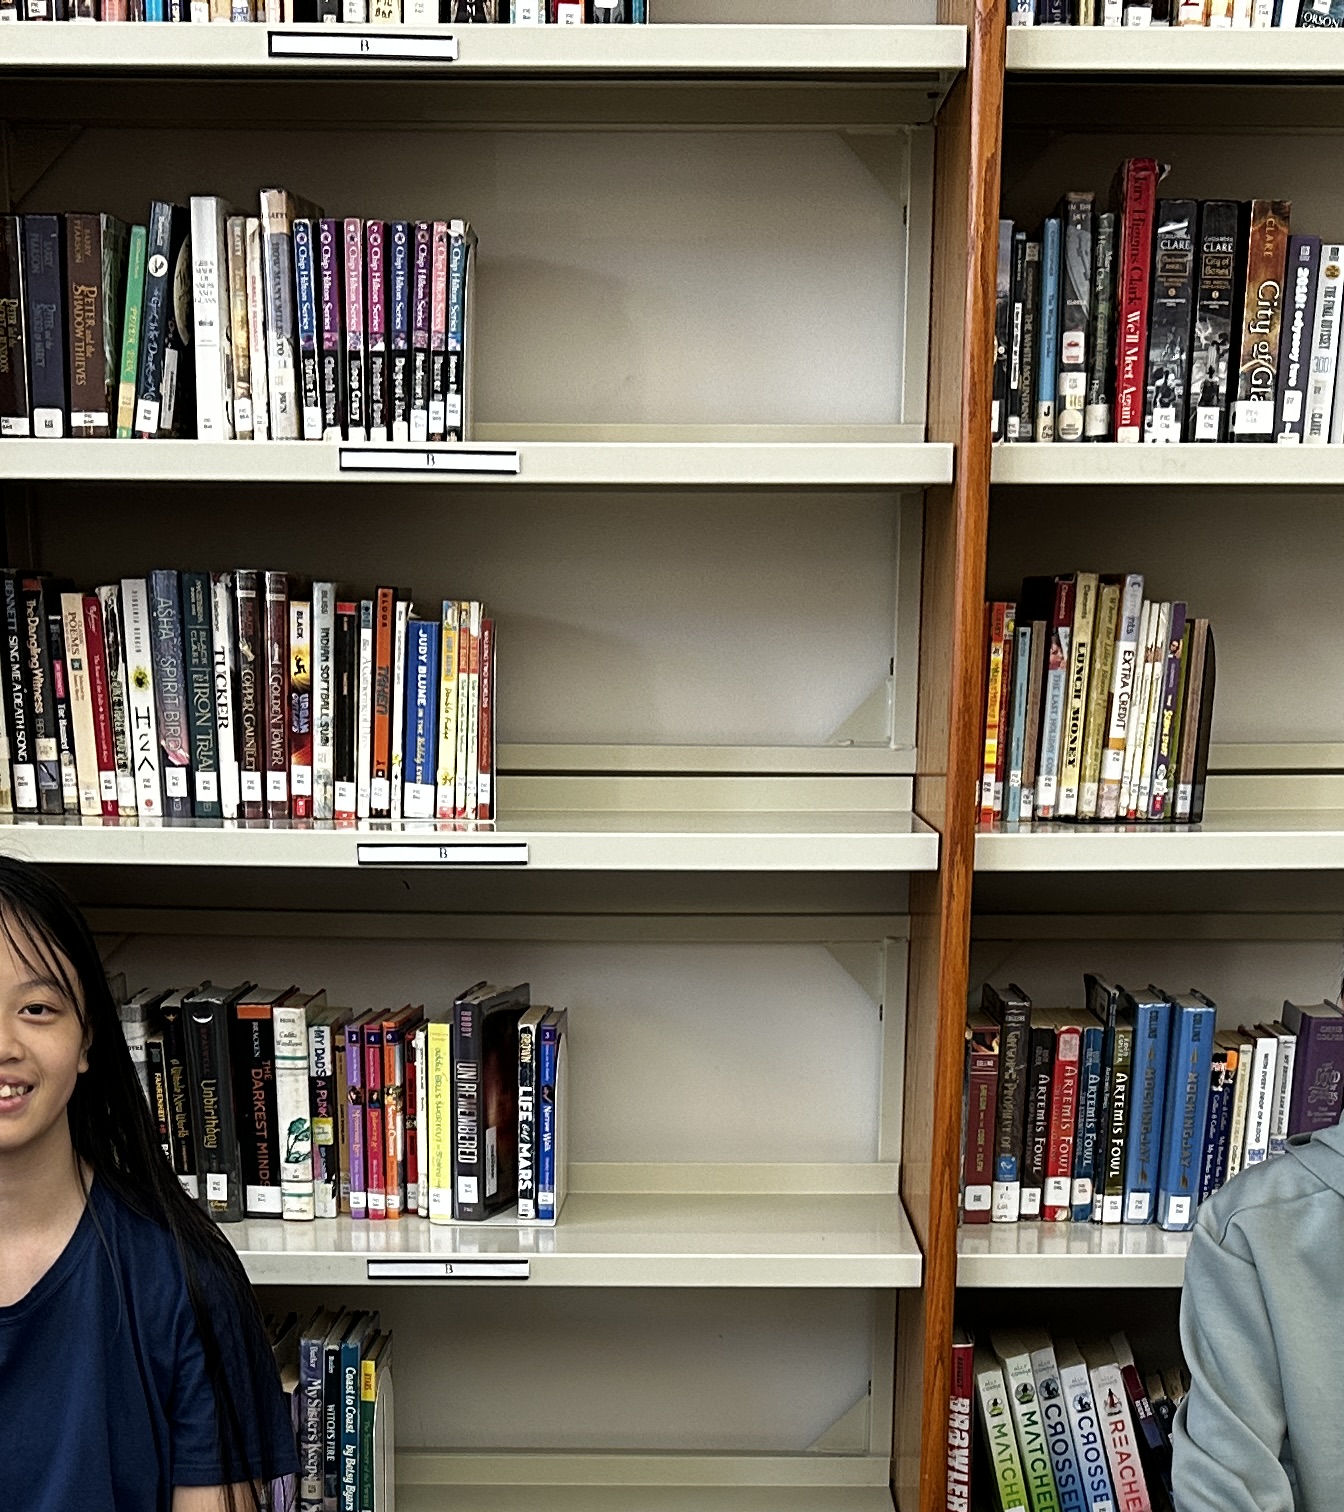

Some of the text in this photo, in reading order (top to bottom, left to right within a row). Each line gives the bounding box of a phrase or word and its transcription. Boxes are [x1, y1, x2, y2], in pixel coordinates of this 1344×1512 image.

[360, 39, 370, 52] B
[1160, 240, 1190, 250] CLARE
[1204, 243, 1233, 252] CLARE
[1265, 218, 1275, 257] CLARE
[82, 285, 97, 328] PETER
[394, 246, 404, 329] Chip Hilton Series
[1250, 281, 1280, 361] City of
[73, 283, 86, 385] SHADOW THIEVES
[1119, 310, 1141, 425] We'll Meet Again
[426, 453, 436, 466] B
[26, 617, 41, 668] Dangling
[296, 611, 304, 639] BLACK
[8, 635, 27, 762] SING ME A DEATH SONG
[31, 669, 44, 714] Witness
[157, 598, 182, 751] ASHA SPIRIT BIRD
[193, 682, 212, 726] IRON
[214, 646, 229, 729] TUCKER
[417, 629, 427, 707] JUDY BLUME
[1066, 642, 1087, 769] LUNCH MONEY
[1115, 650, 1135, 731] EXTRA CREDIT
[270, 673, 284, 766] GOLDEN TOWER
[439, 847, 448, 859] B
[261, 1060, 272, 1080] THE
[519, 1086, 533, 1122] LIFE
[200, 1079, 220, 1149] Unbirthday
[251, 1068, 271, 1187] DARKEST MINDS
[457, 1062, 478, 1164] UNREMEMBERED
[1057, 1065, 1078, 1176] ARTEMIS FOWL
[1109, 1072, 1128, 1178] ARTEMIS FOWL
[1139, 1069, 1156, 1162] MOCKINGJAY
[1181, 1072, 1200, 1167] MOCKINGJAY
[518, 1144, 533, 1191] MARS
[444, 1264, 454, 1275] B
[326, 1441, 336, 1462] FIRE
[343, 1367, 356, 1511] Coast to Coast by Betsy Byars
